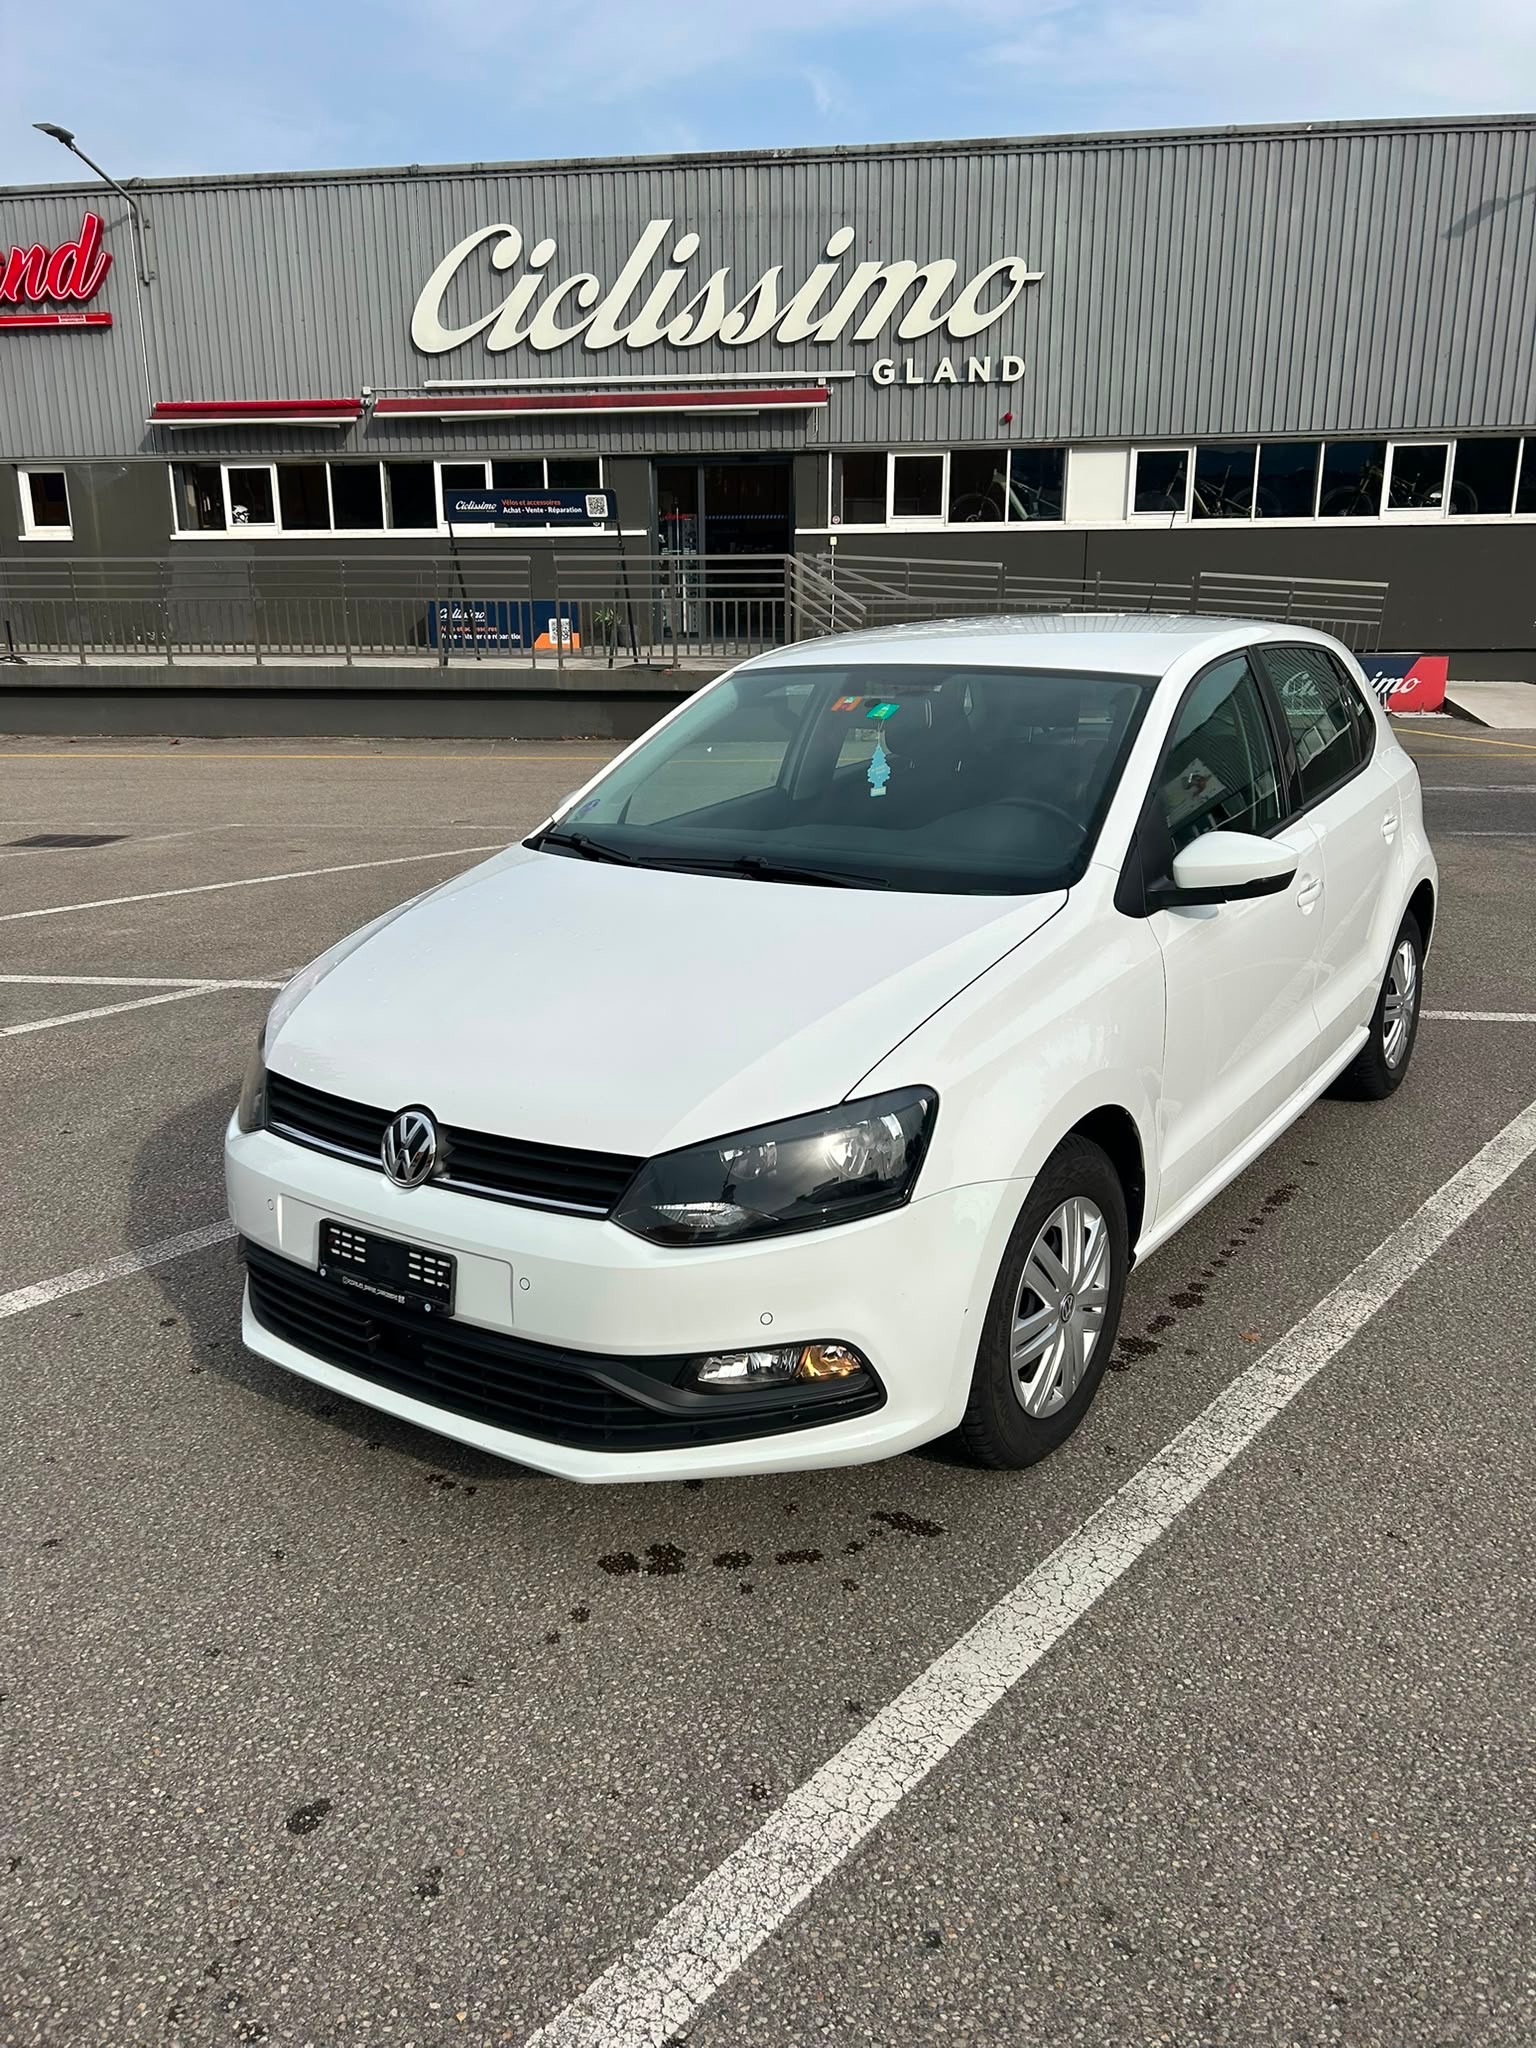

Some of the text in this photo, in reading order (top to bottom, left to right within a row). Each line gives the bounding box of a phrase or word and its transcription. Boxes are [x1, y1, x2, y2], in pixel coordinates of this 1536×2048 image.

[0, 212, 111, 303] nd
[411, 218, 1045, 354] Ciclissimo
[872, 355, 1027, 386] GLAND
[455, 500, 498, 511] Ciclissimo
[547, 506, 583, 514] Réparation
[1369, 671, 1422, 694] imo
